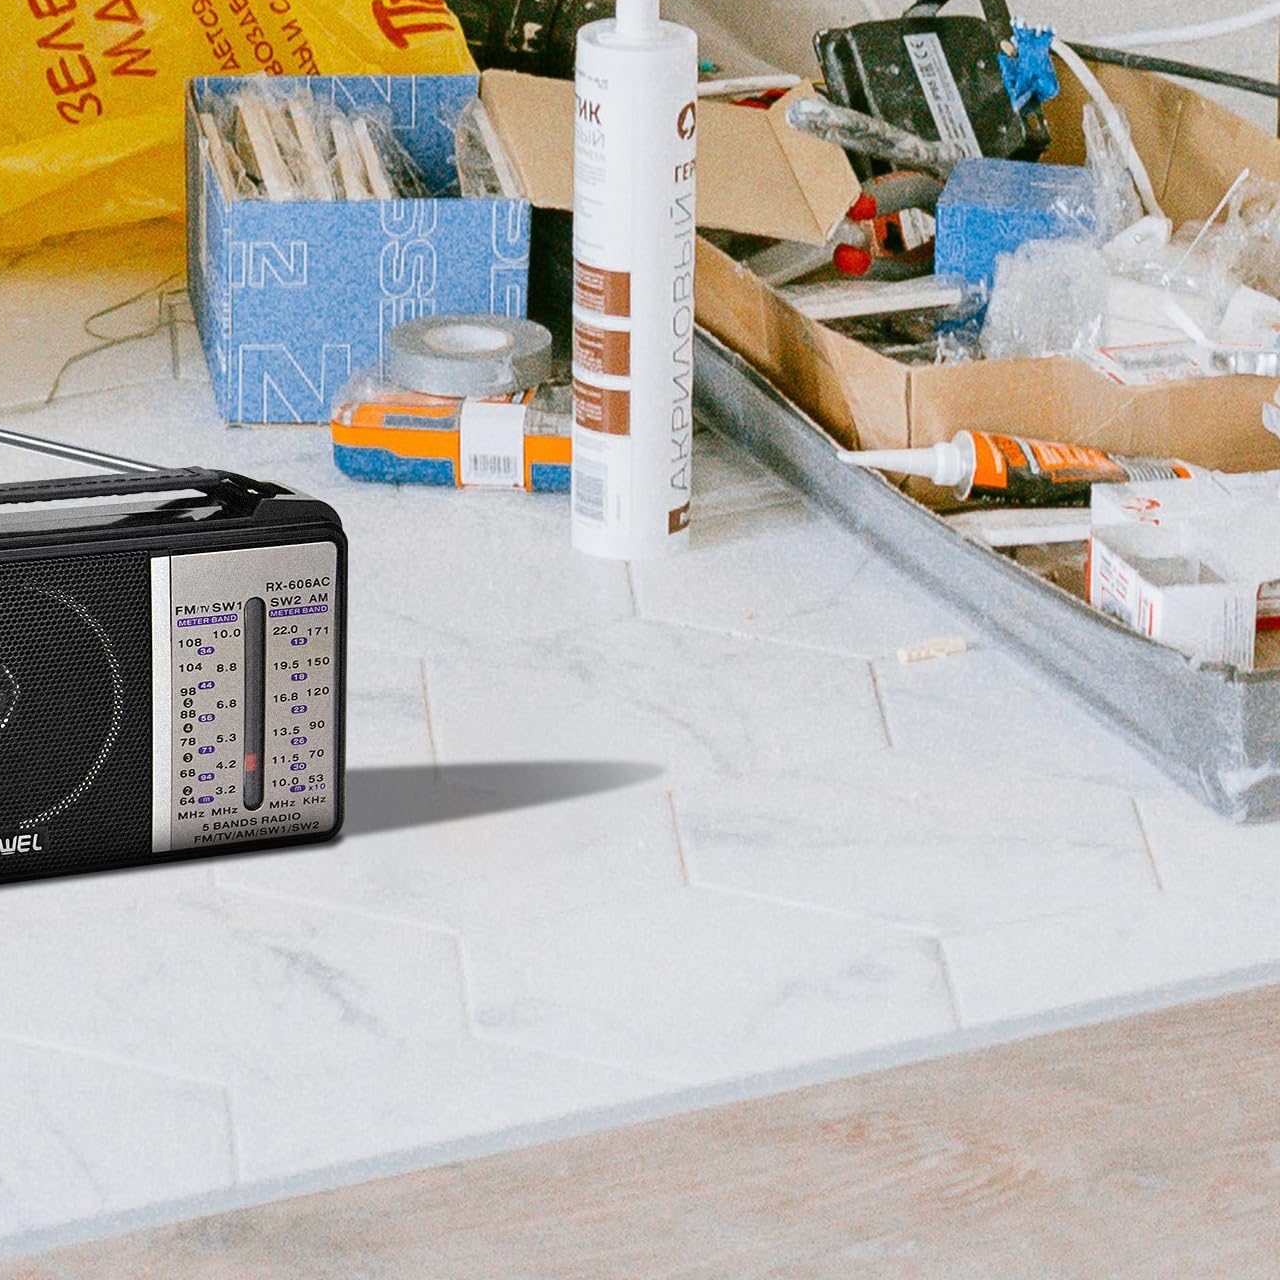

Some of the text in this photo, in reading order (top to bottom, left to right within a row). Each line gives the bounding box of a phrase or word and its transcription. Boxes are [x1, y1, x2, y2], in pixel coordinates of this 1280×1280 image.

[669, 192, 695, 491] АКРИЛОВЫЙ
[266, 576, 331, 593] RX-606AC
[270, 593, 329, 608] SW2 AM
[175, 601, 243, 616] FM/TV SW1
[270, 605, 328, 618] METER BAND
[177, 614, 237, 627] METER BAND
[213, 628, 241, 639] 10.0
[272, 625, 298, 636] 22.0
[307, 626, 330, 637] 171
[178, 638, 202, 649] 108
[179, 662, 203, 673] 104
[273, 660, 300, 671] 19.5
[307, 657, 330, 667] 150
[216, 663, 238, 673] 8.8
[180, 687, 197, 697] 98
[306, 686, 330, 697] 120
[273, 692, 299, 703] 16.8
[216, 699, 237, 709] 6.8
[180, 709, 197, 719] 88
[309, 720, 326, 730] 90
[272, 726, 301, 737] 13.5
[179, 737, 197, 747] 78
[216, 733, 237, 744] 5.3
[272, 754, 300, 765] 11.5
[308, 749, 325, 759] 70
[215, 760, 237, 770] 4.2
[179, 769, 197, 779] 68
[308, 774, 325, 784] 53
[271, 777, 299, 788] 10.0
[215, 785, 237, 795] 3.2
[179, 796, 196, 806] 64
[269, 796, 327, 810] MHz KHz
[177, 807, 239, 821] MHz MHz
[202, 812, 301, 832] 5 BANDS RADIO
